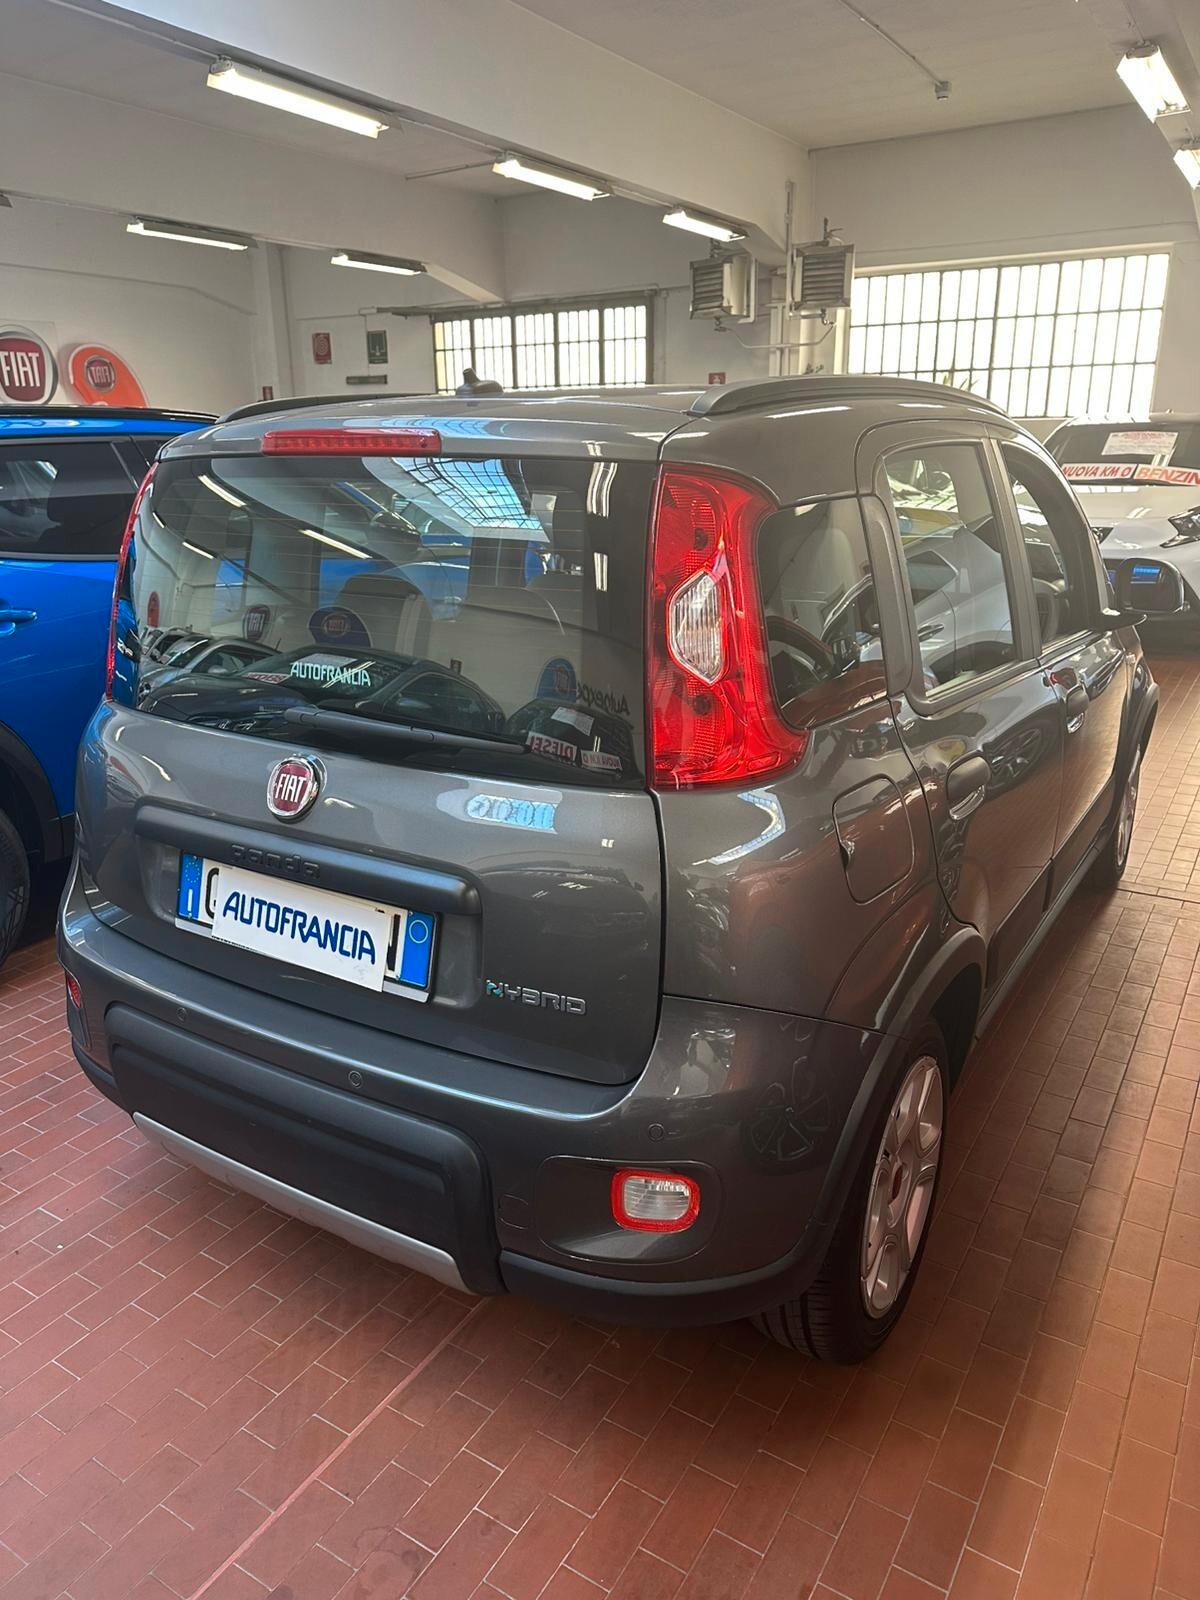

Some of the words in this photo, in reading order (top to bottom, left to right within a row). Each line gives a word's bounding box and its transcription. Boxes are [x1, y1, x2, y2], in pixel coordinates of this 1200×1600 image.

[0, 351, 40, 387] FIAT
[1062, 466, 1100, 477] NUOVA
[1100, 466, 1120, 477] KM
[290, 661, 371, 687] AUTOFRANCIA
[277, 772, 307, 803] FIAT
[222, 891, 376, 964] AUTOFRANCIA
[485, 979, 587, 1015] HYBRID
